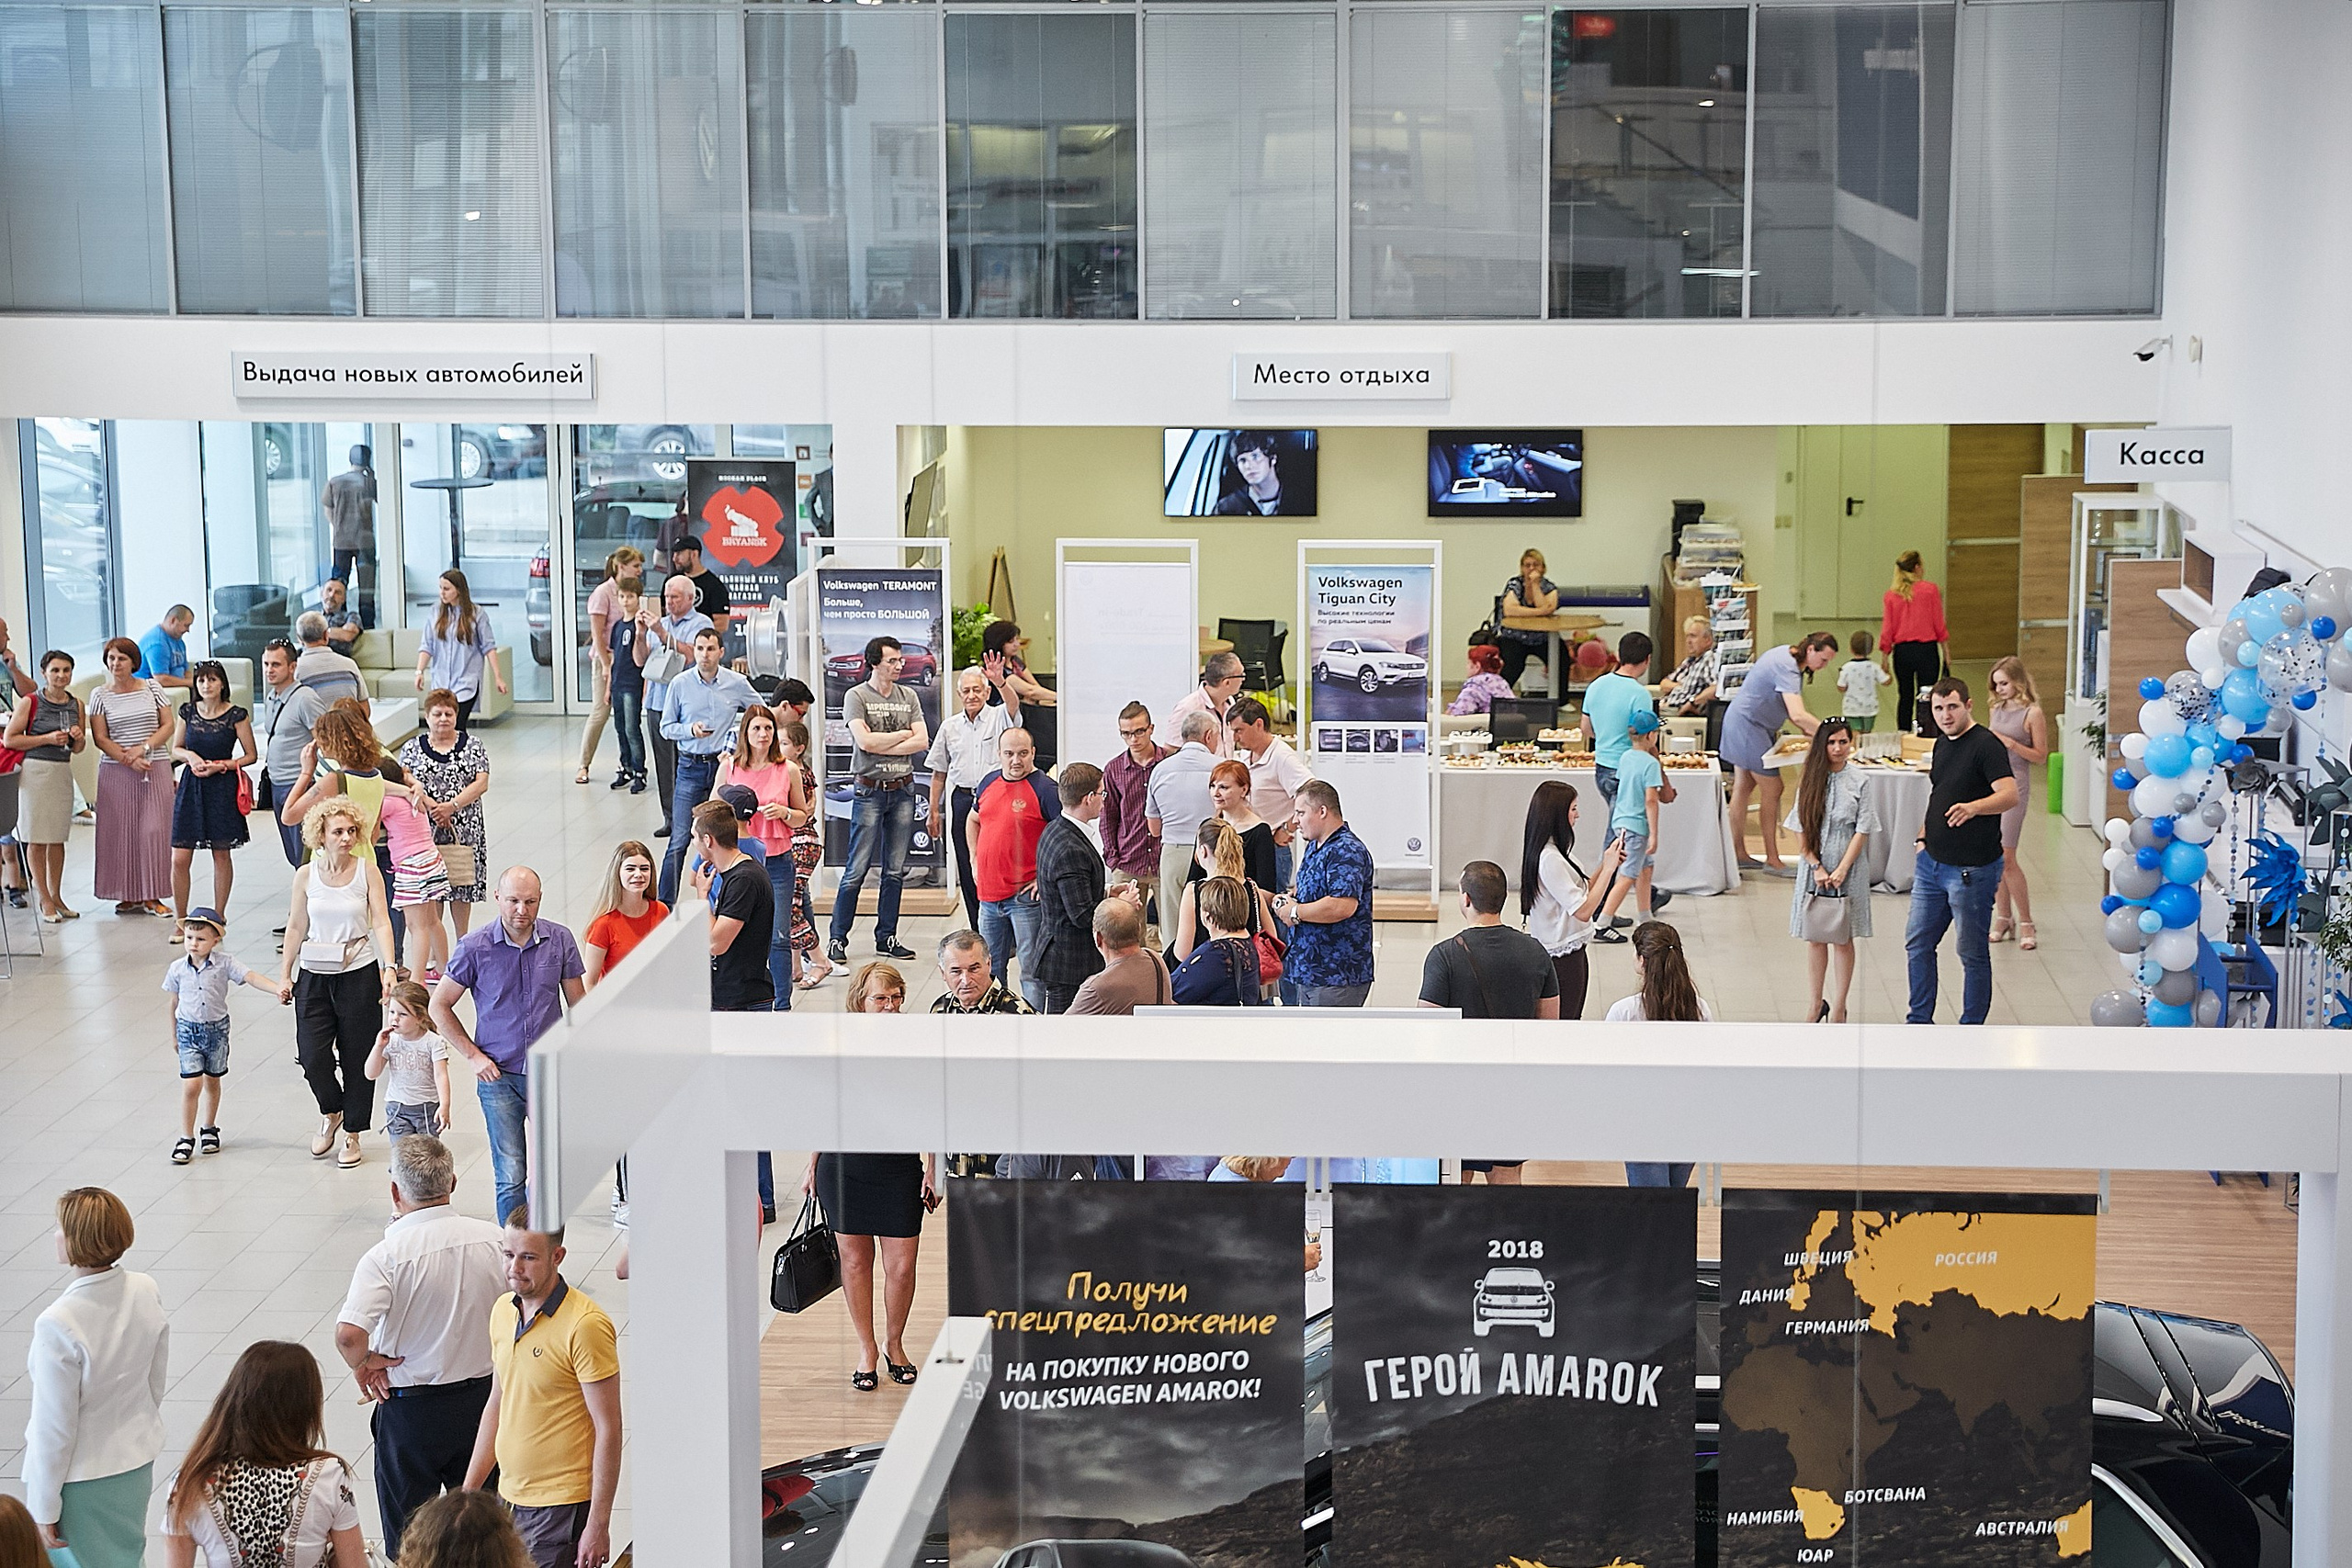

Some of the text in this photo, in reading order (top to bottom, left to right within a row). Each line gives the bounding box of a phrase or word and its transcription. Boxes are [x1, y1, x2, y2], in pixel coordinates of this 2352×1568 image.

[243, 361, 582, 385] Выдача новых автомобилей
[1253, 363, 1430, 387] Место отдыха
[2119, 442, 2205, 466] Касса
[721, 536, 767, 547] BRYANSK
[822, 580, 937, 592] Volkswagen TERAMONT
[1317, 576, 1403, 591] Volkswagen
[823, 597, 864, 608] Больше,
[1317, 592, 1396, 607] Tiguan City
[843, 611, 876, 620] просто
[877, 608, 930, 619] БОЛЬШОЙ
[1487, 1239, 1544, 1258] 2018
[1783, 1249, 1853, 1267] ШВЕЦИЯ
[1934, 1250, 1998, 1267] РОССИЯ
[1067, 1269, 1188, 1311] Получи
[1738, 1287, 1795, 1305] ДАНИЯ
[1784, 1318, 1871, 1336] ГЕРМАНИЯ
[1005, 1362, 1036, 1382] НА
[1042, 1354, 1149, 1381] ПОКУПКУ
[1153, 1349, 1250, 1374] НОВОГО
[1364, 1347, 1664, 1407] ГЕРОЙ AMAROK
[999, 1378, 1262, 1411] VOLKSWAGEN AMAROK!
[1844, 1486, 1926, 1505] БОТСВАНА
[1725, 1509, 1804, 1527] НАМИБИЯ
[1974, 1520, 2070, 1538] АВСТРАЛИЯ
[1797, 1548, 1834, 1563] ЮАР
